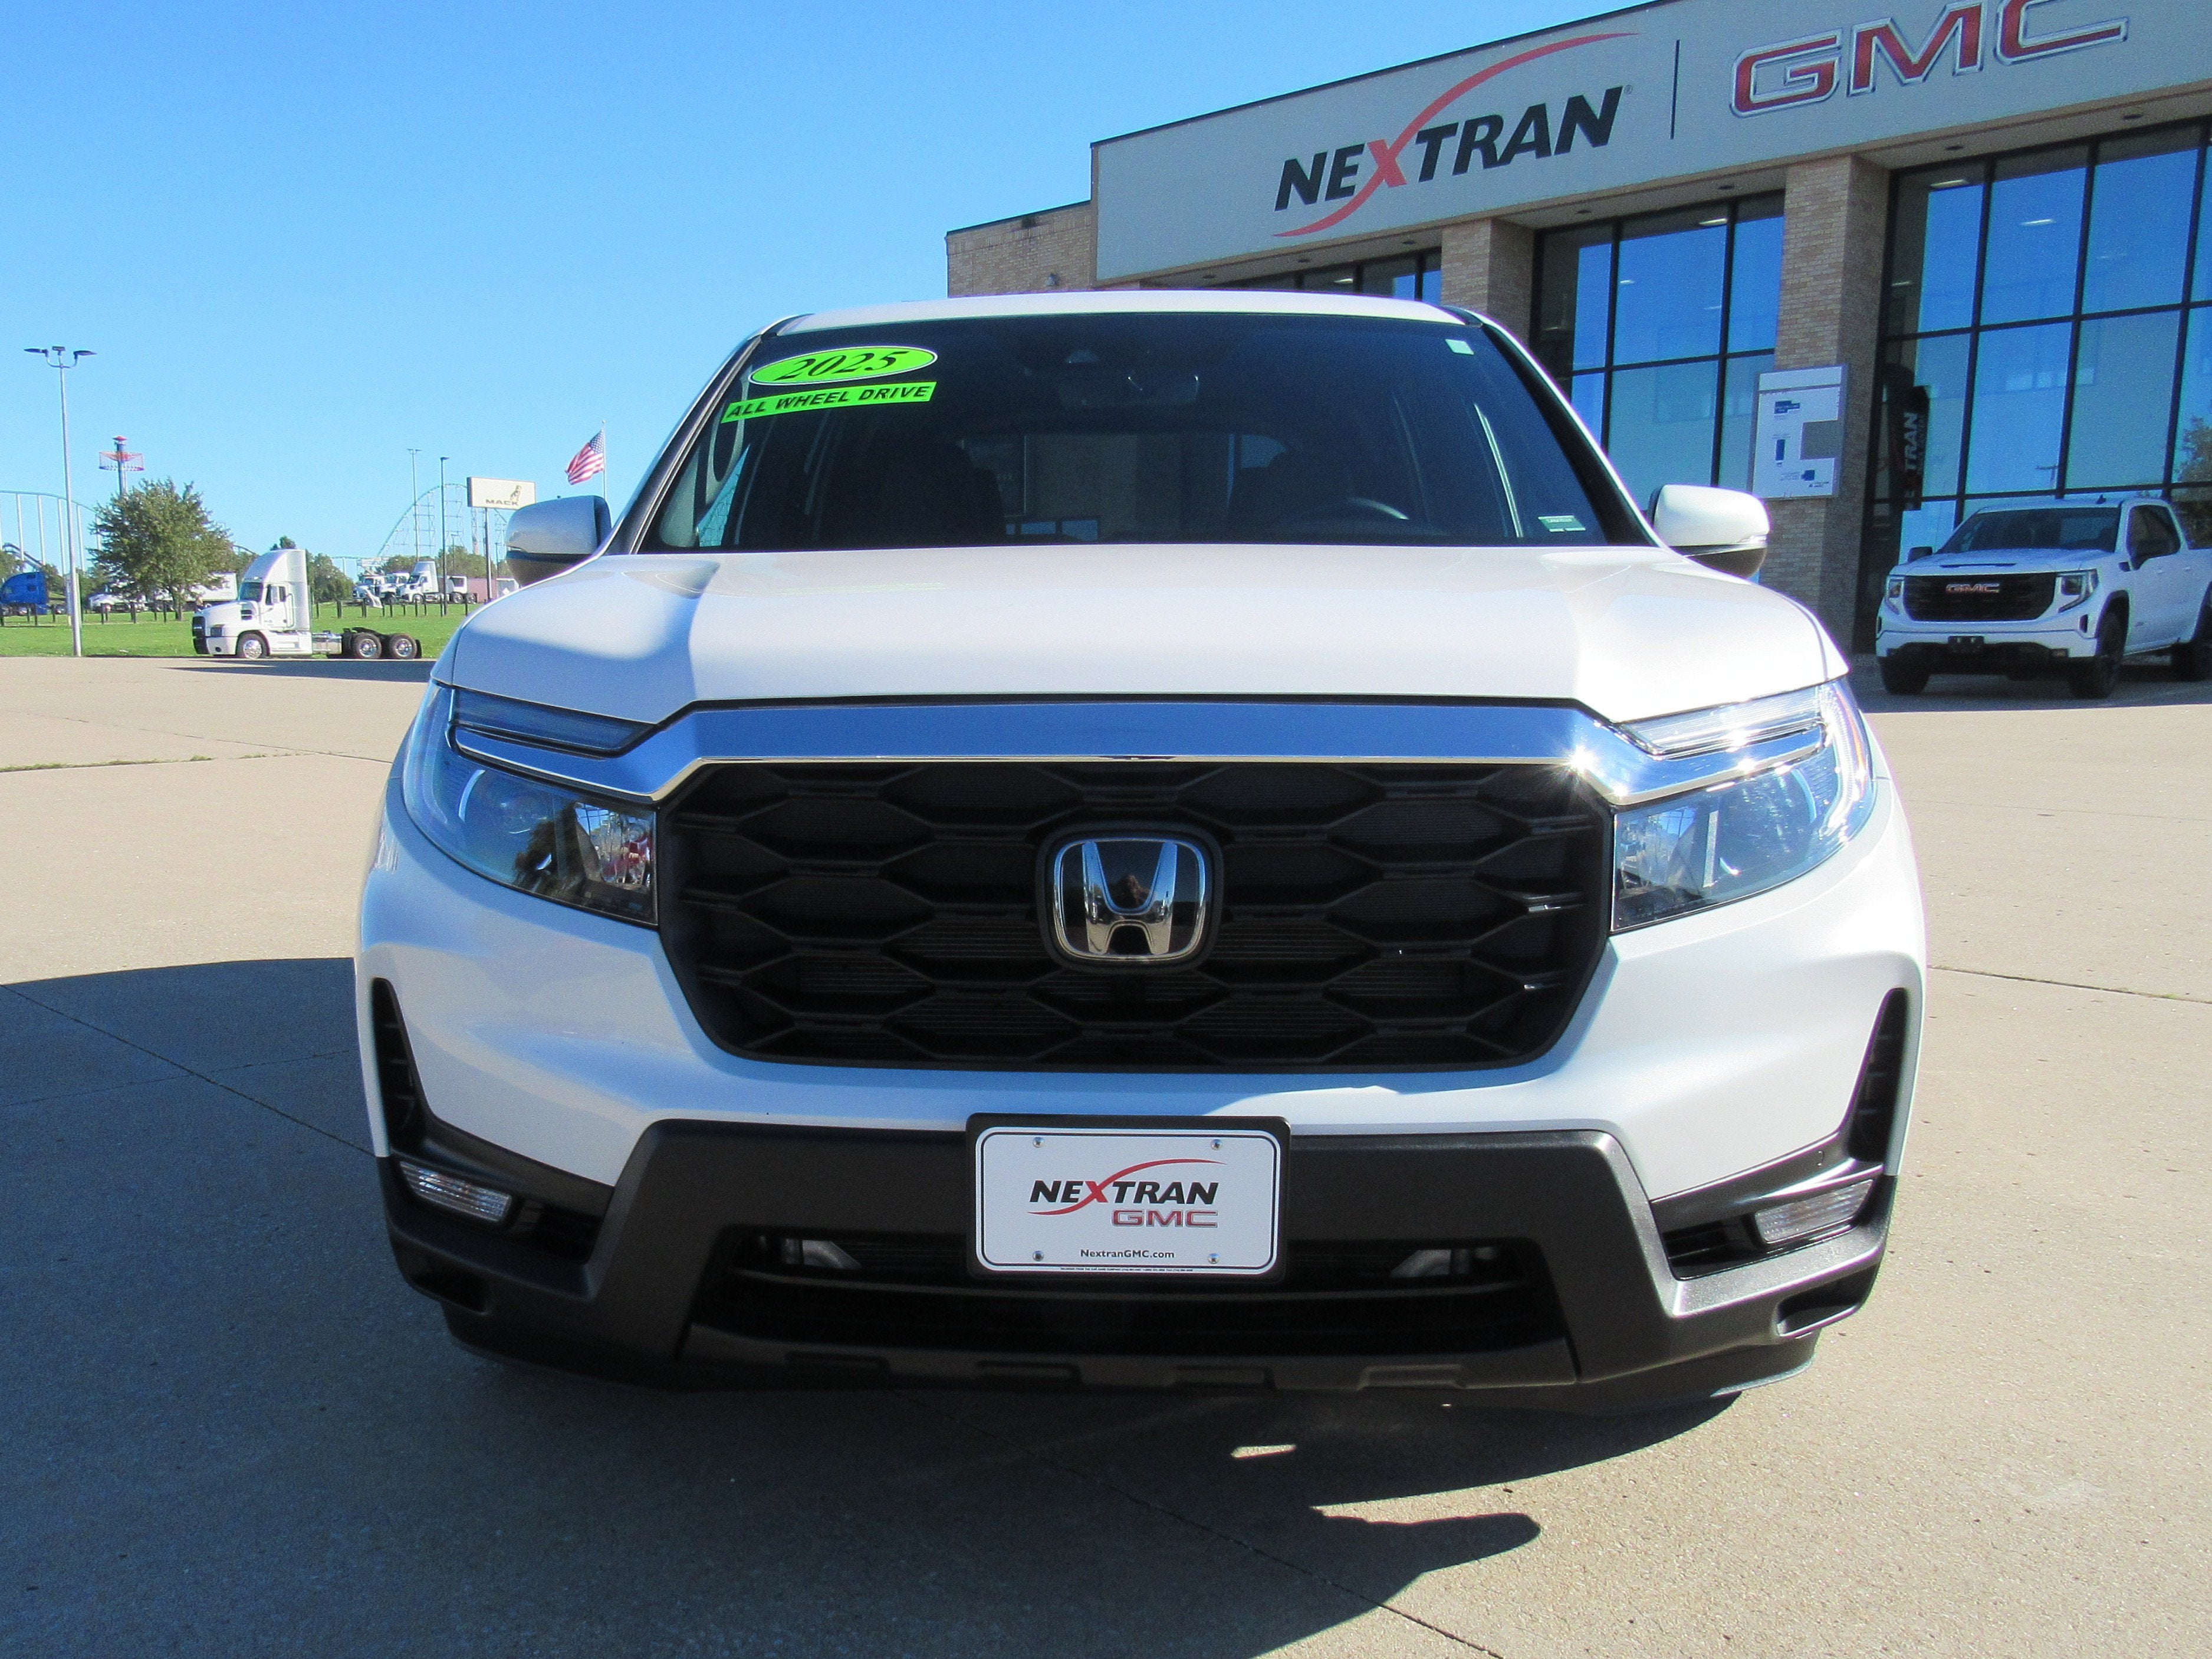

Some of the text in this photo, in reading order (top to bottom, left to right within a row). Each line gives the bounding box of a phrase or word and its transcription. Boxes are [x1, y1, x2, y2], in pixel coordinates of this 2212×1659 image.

[1730, 0, 2129, 117] GMC
[1274, 86, 1623, 211] NEXTRAN
[773, 350, 909, 381] 2025
[727, 385, 931, 418] ALL WHEEL DRIVE
[1945, 583, 2000, 593] GMC
[1029, 1180, 1219, 1205] NEXTRAN
[1111, 1208, 1219, 1228] GMC
[1080, 1249, 1175, 1259] NextranGMC.com
